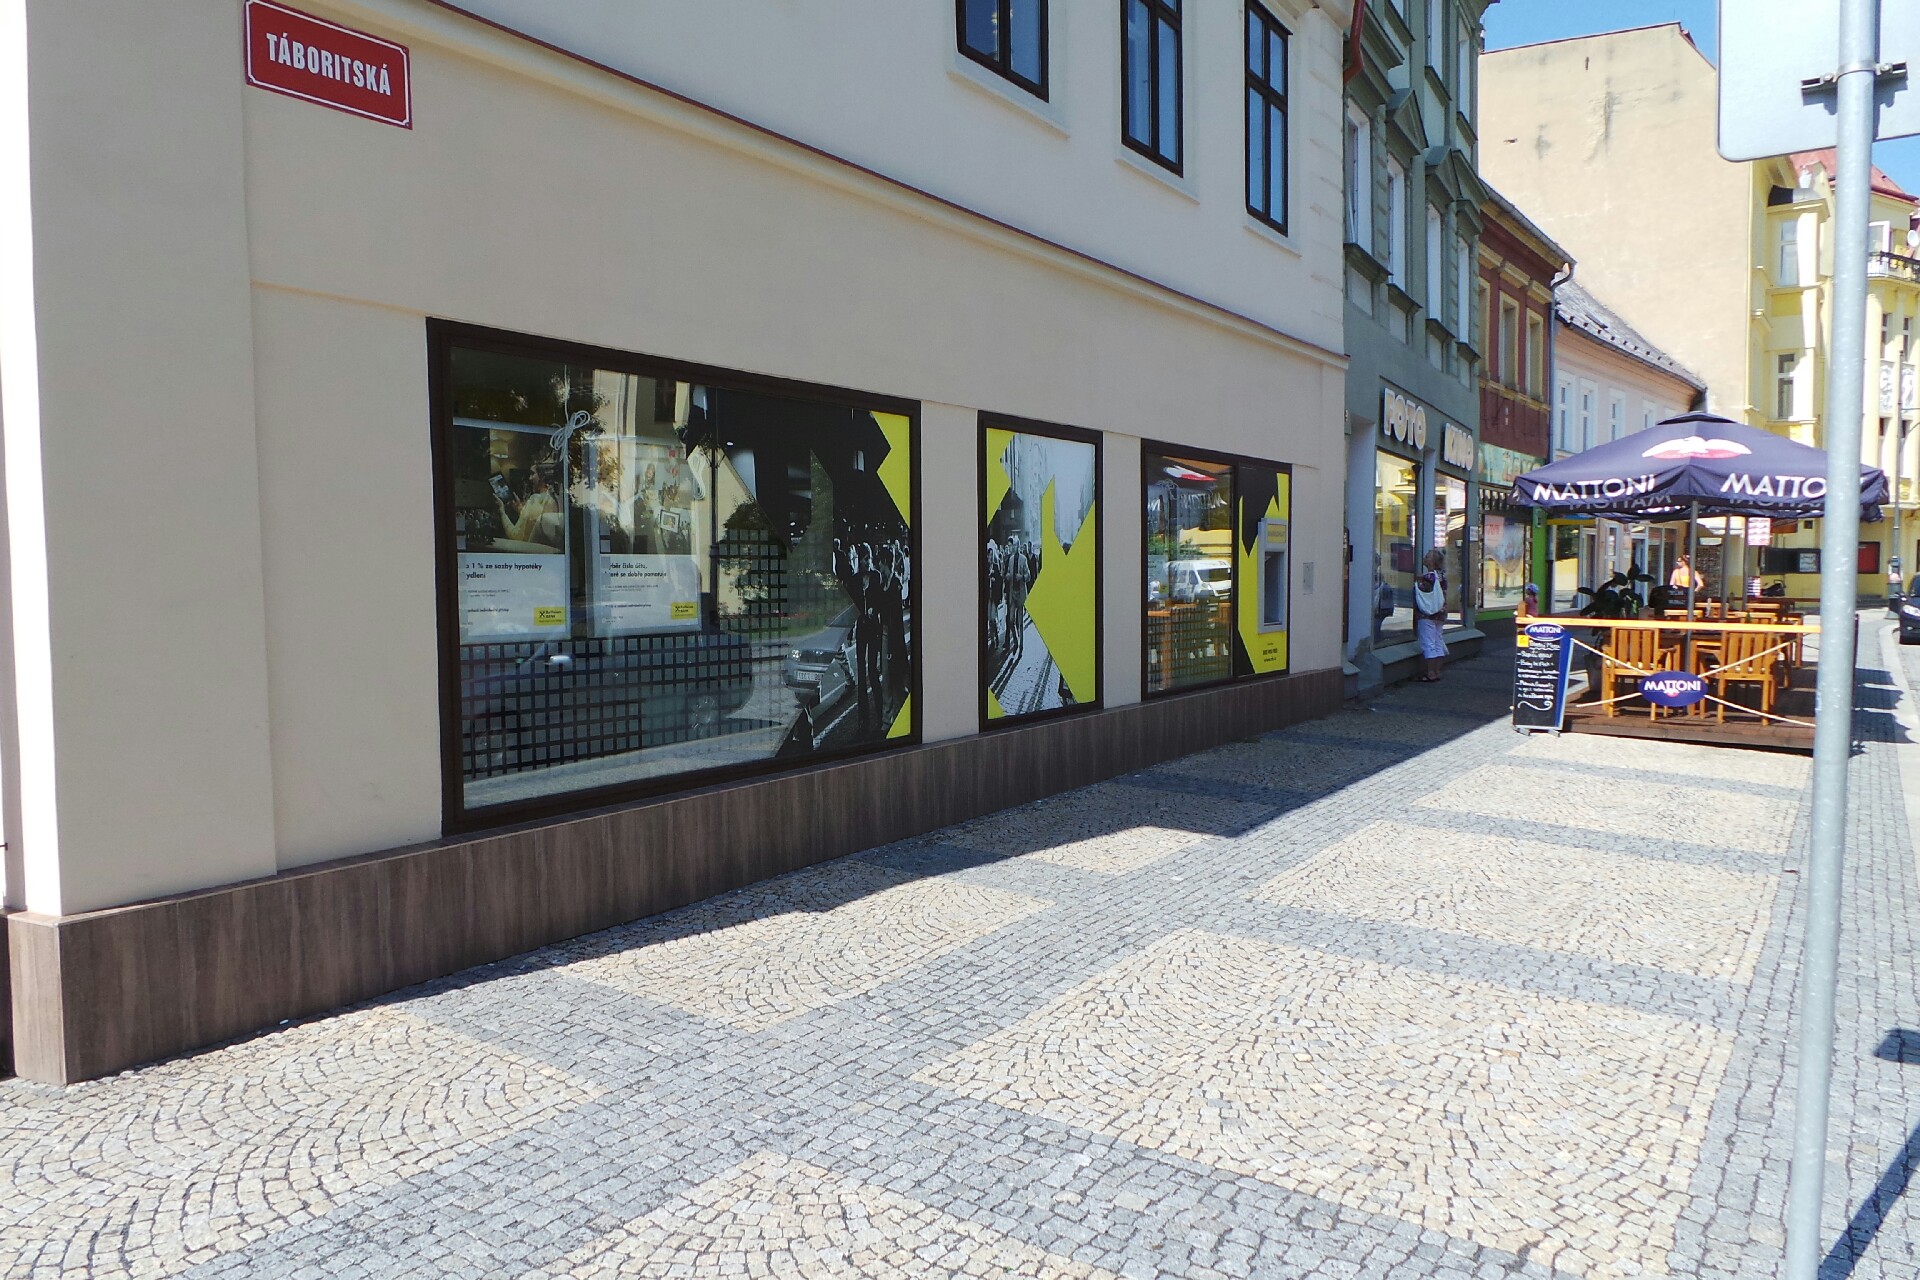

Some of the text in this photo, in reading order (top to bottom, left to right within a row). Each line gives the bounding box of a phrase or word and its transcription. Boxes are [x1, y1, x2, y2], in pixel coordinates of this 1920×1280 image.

[266, 32, 391, 96] TÁBORITSKÁ
[1383, 387, 1426, 450] FOTO
[1533, 474, 1655, 500] MATTONI
[1720, 473, 1826, 498] MATTO
[1529, 626, 1561, 634] MATTONI
[1644, 679, 1702, 692] MATTONI
